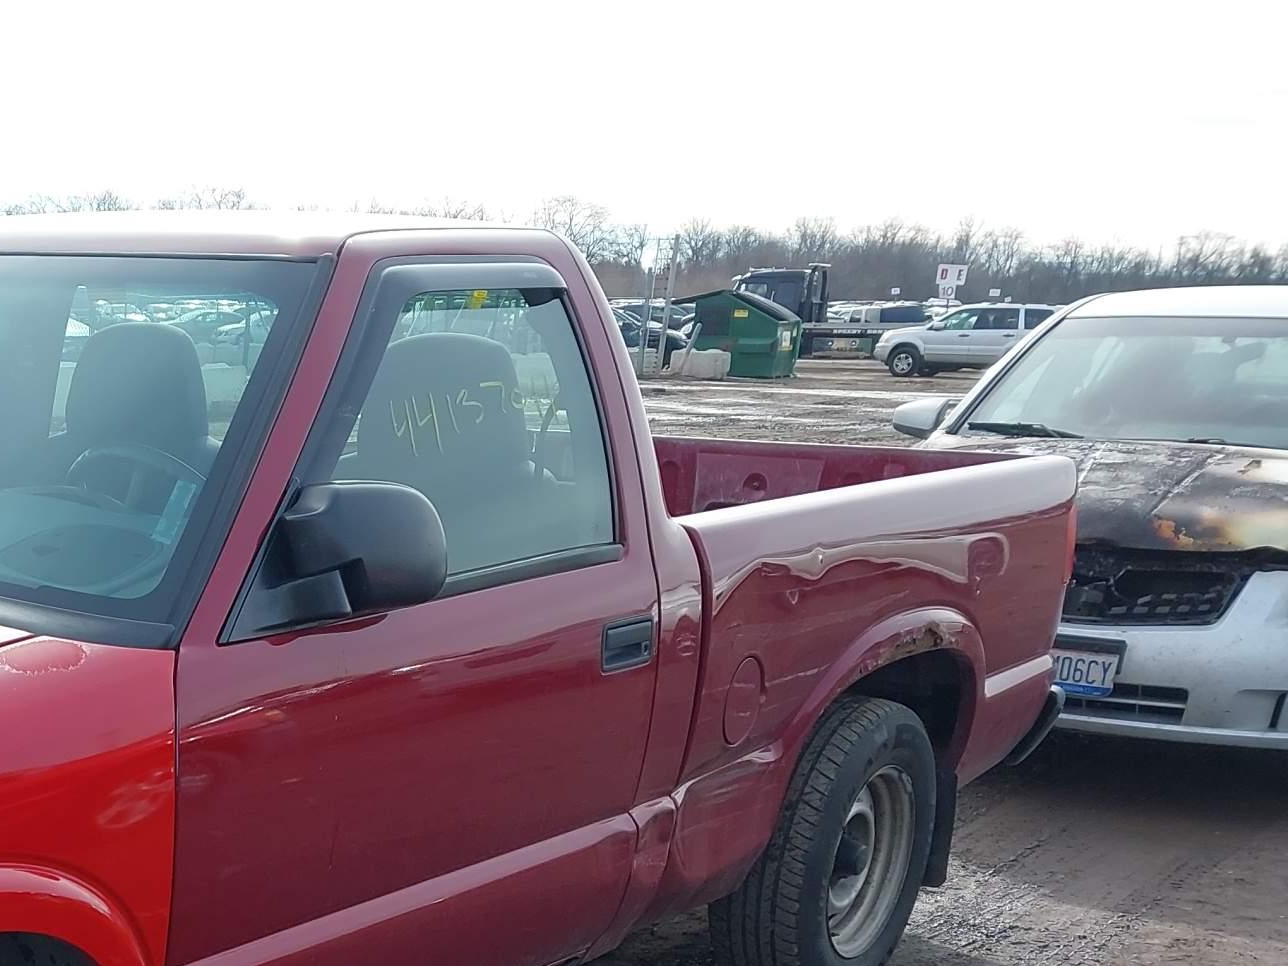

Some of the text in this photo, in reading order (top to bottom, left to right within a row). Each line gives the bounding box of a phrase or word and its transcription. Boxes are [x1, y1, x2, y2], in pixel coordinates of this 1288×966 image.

[939, 268, 964, 281] D E
[941, 286, 954, 297] 10
